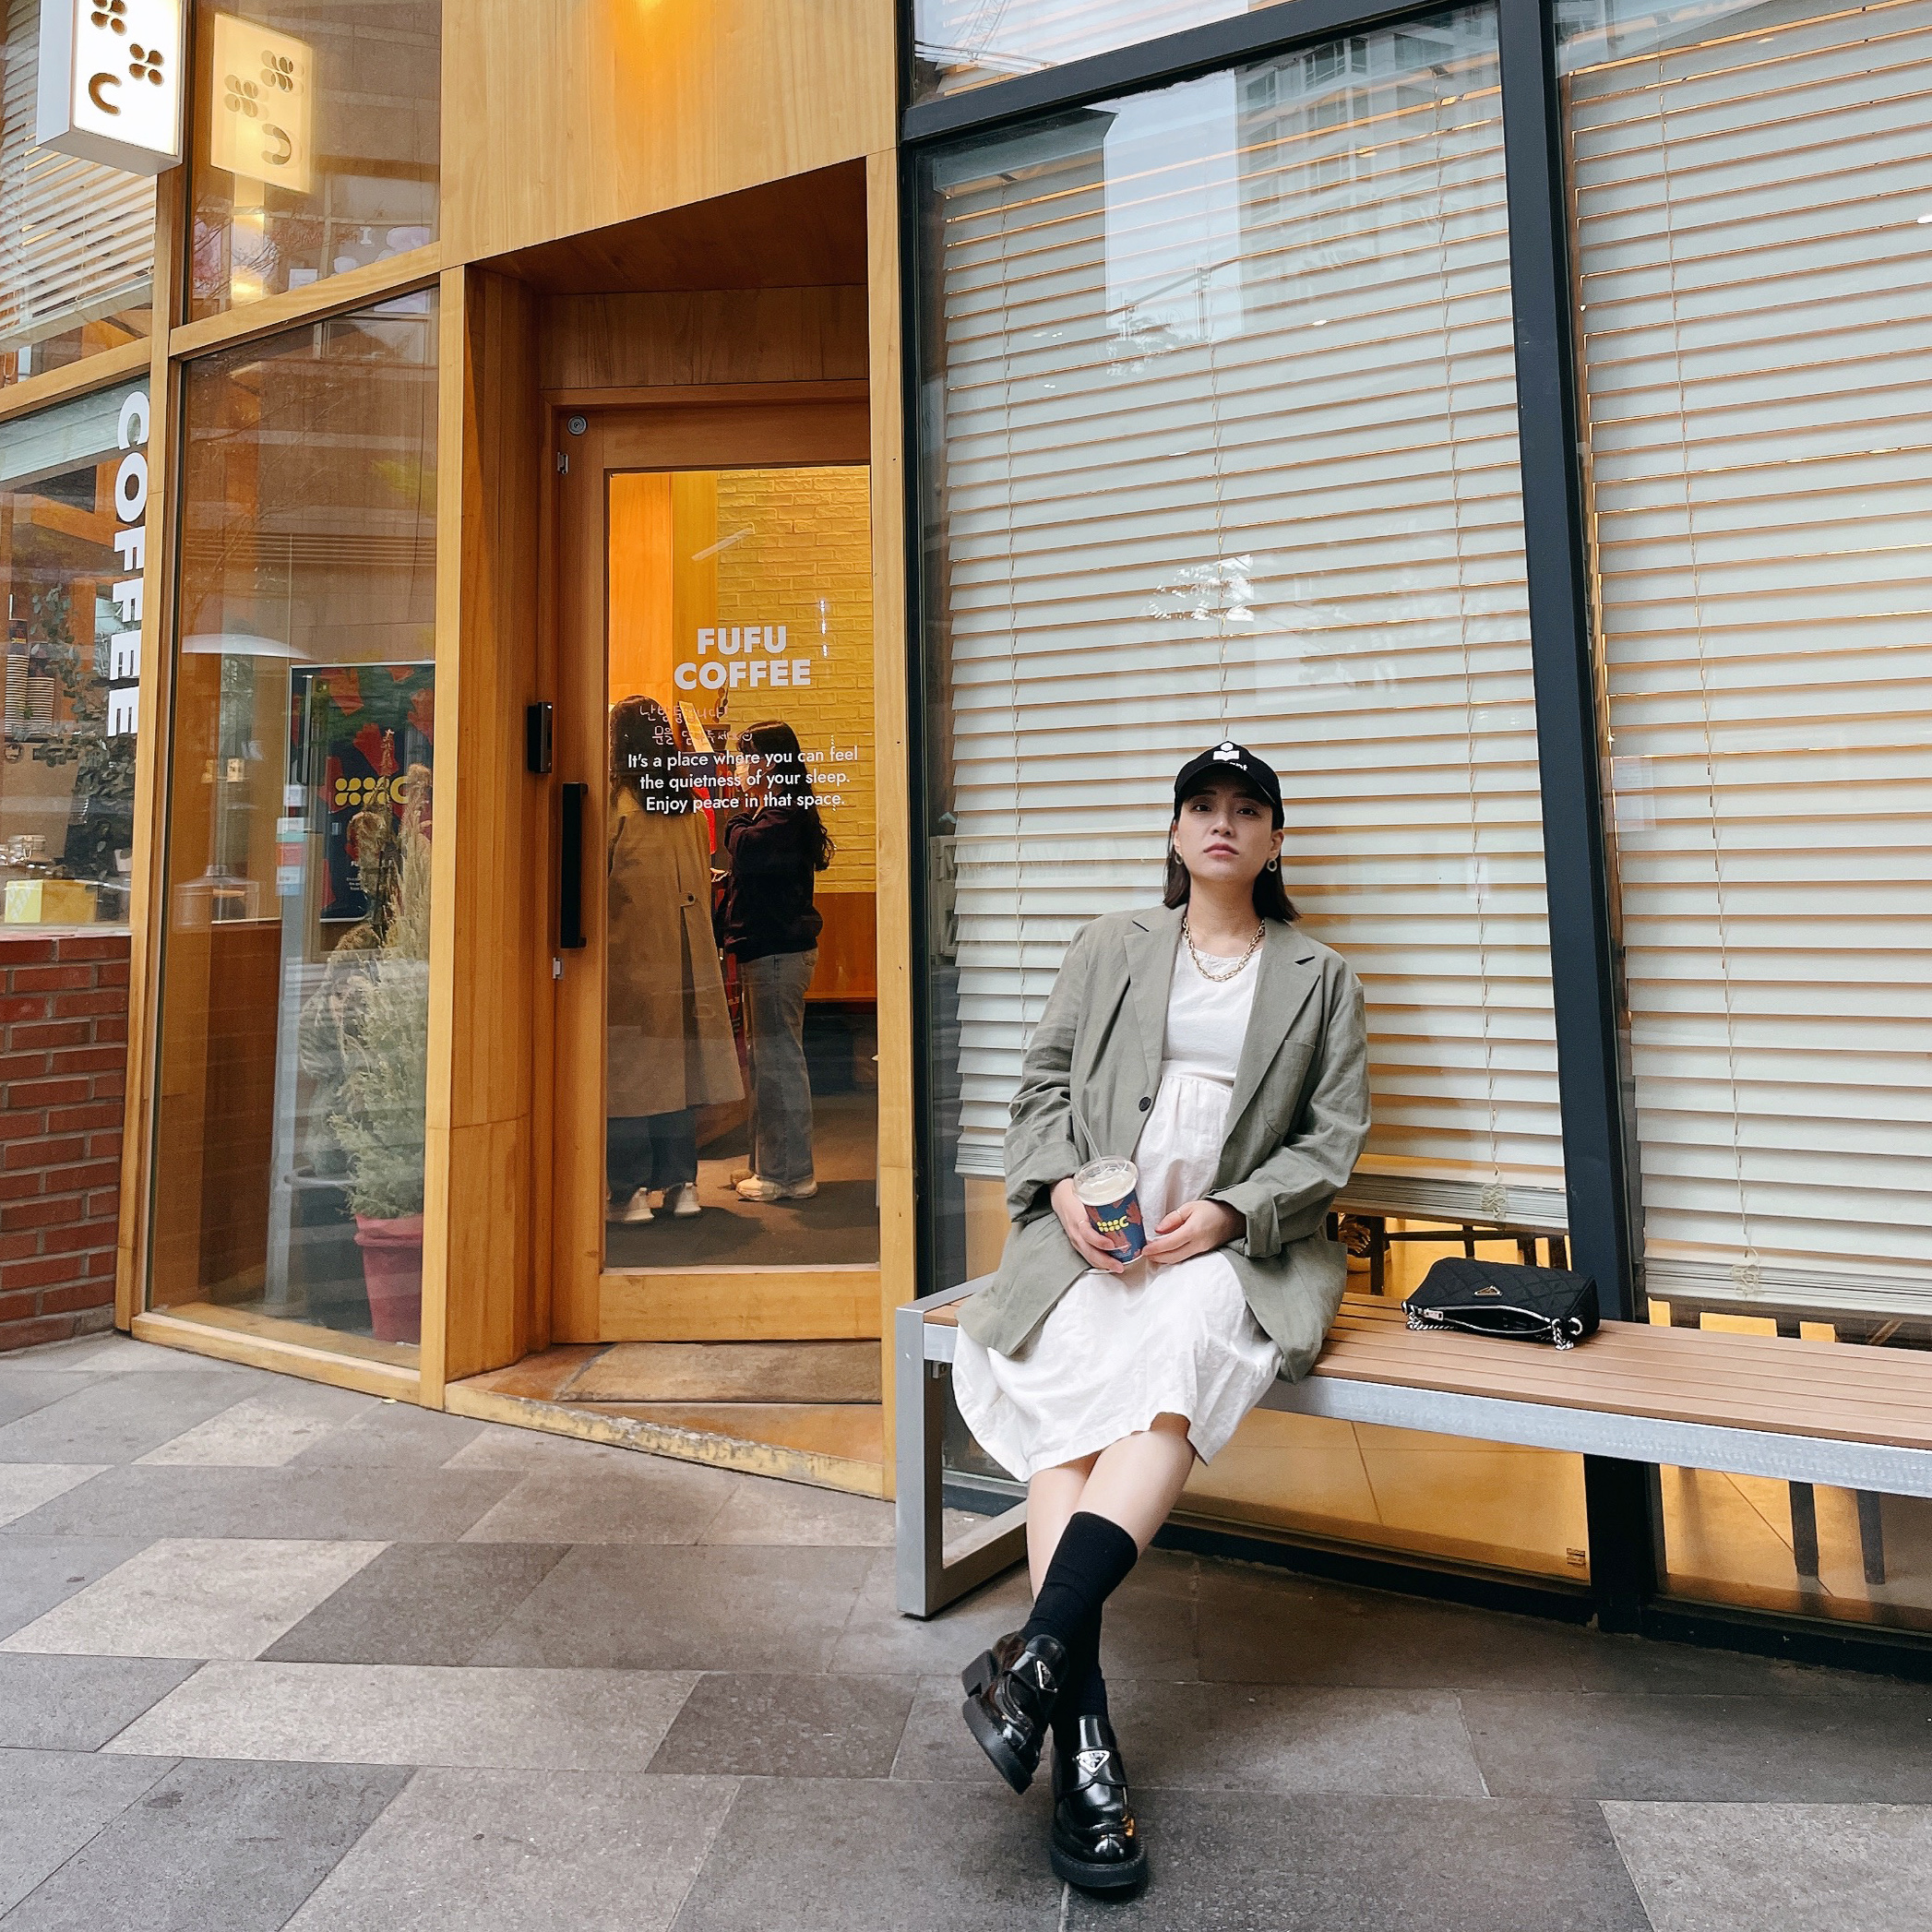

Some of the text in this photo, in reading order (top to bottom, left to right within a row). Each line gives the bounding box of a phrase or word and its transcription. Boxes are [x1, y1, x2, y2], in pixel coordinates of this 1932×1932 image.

[107, 390, 150, 738] COFFEE
[698, 626, 787, 656] FUFU
[674, 659, 811, 691] COFFEE
[627, 745, 858, 771] It's a place where you can feel
[639, 768, 851, 793] the quietness of your sleep.
[646, 792, 845, 815] Enjoy peace in that space.
